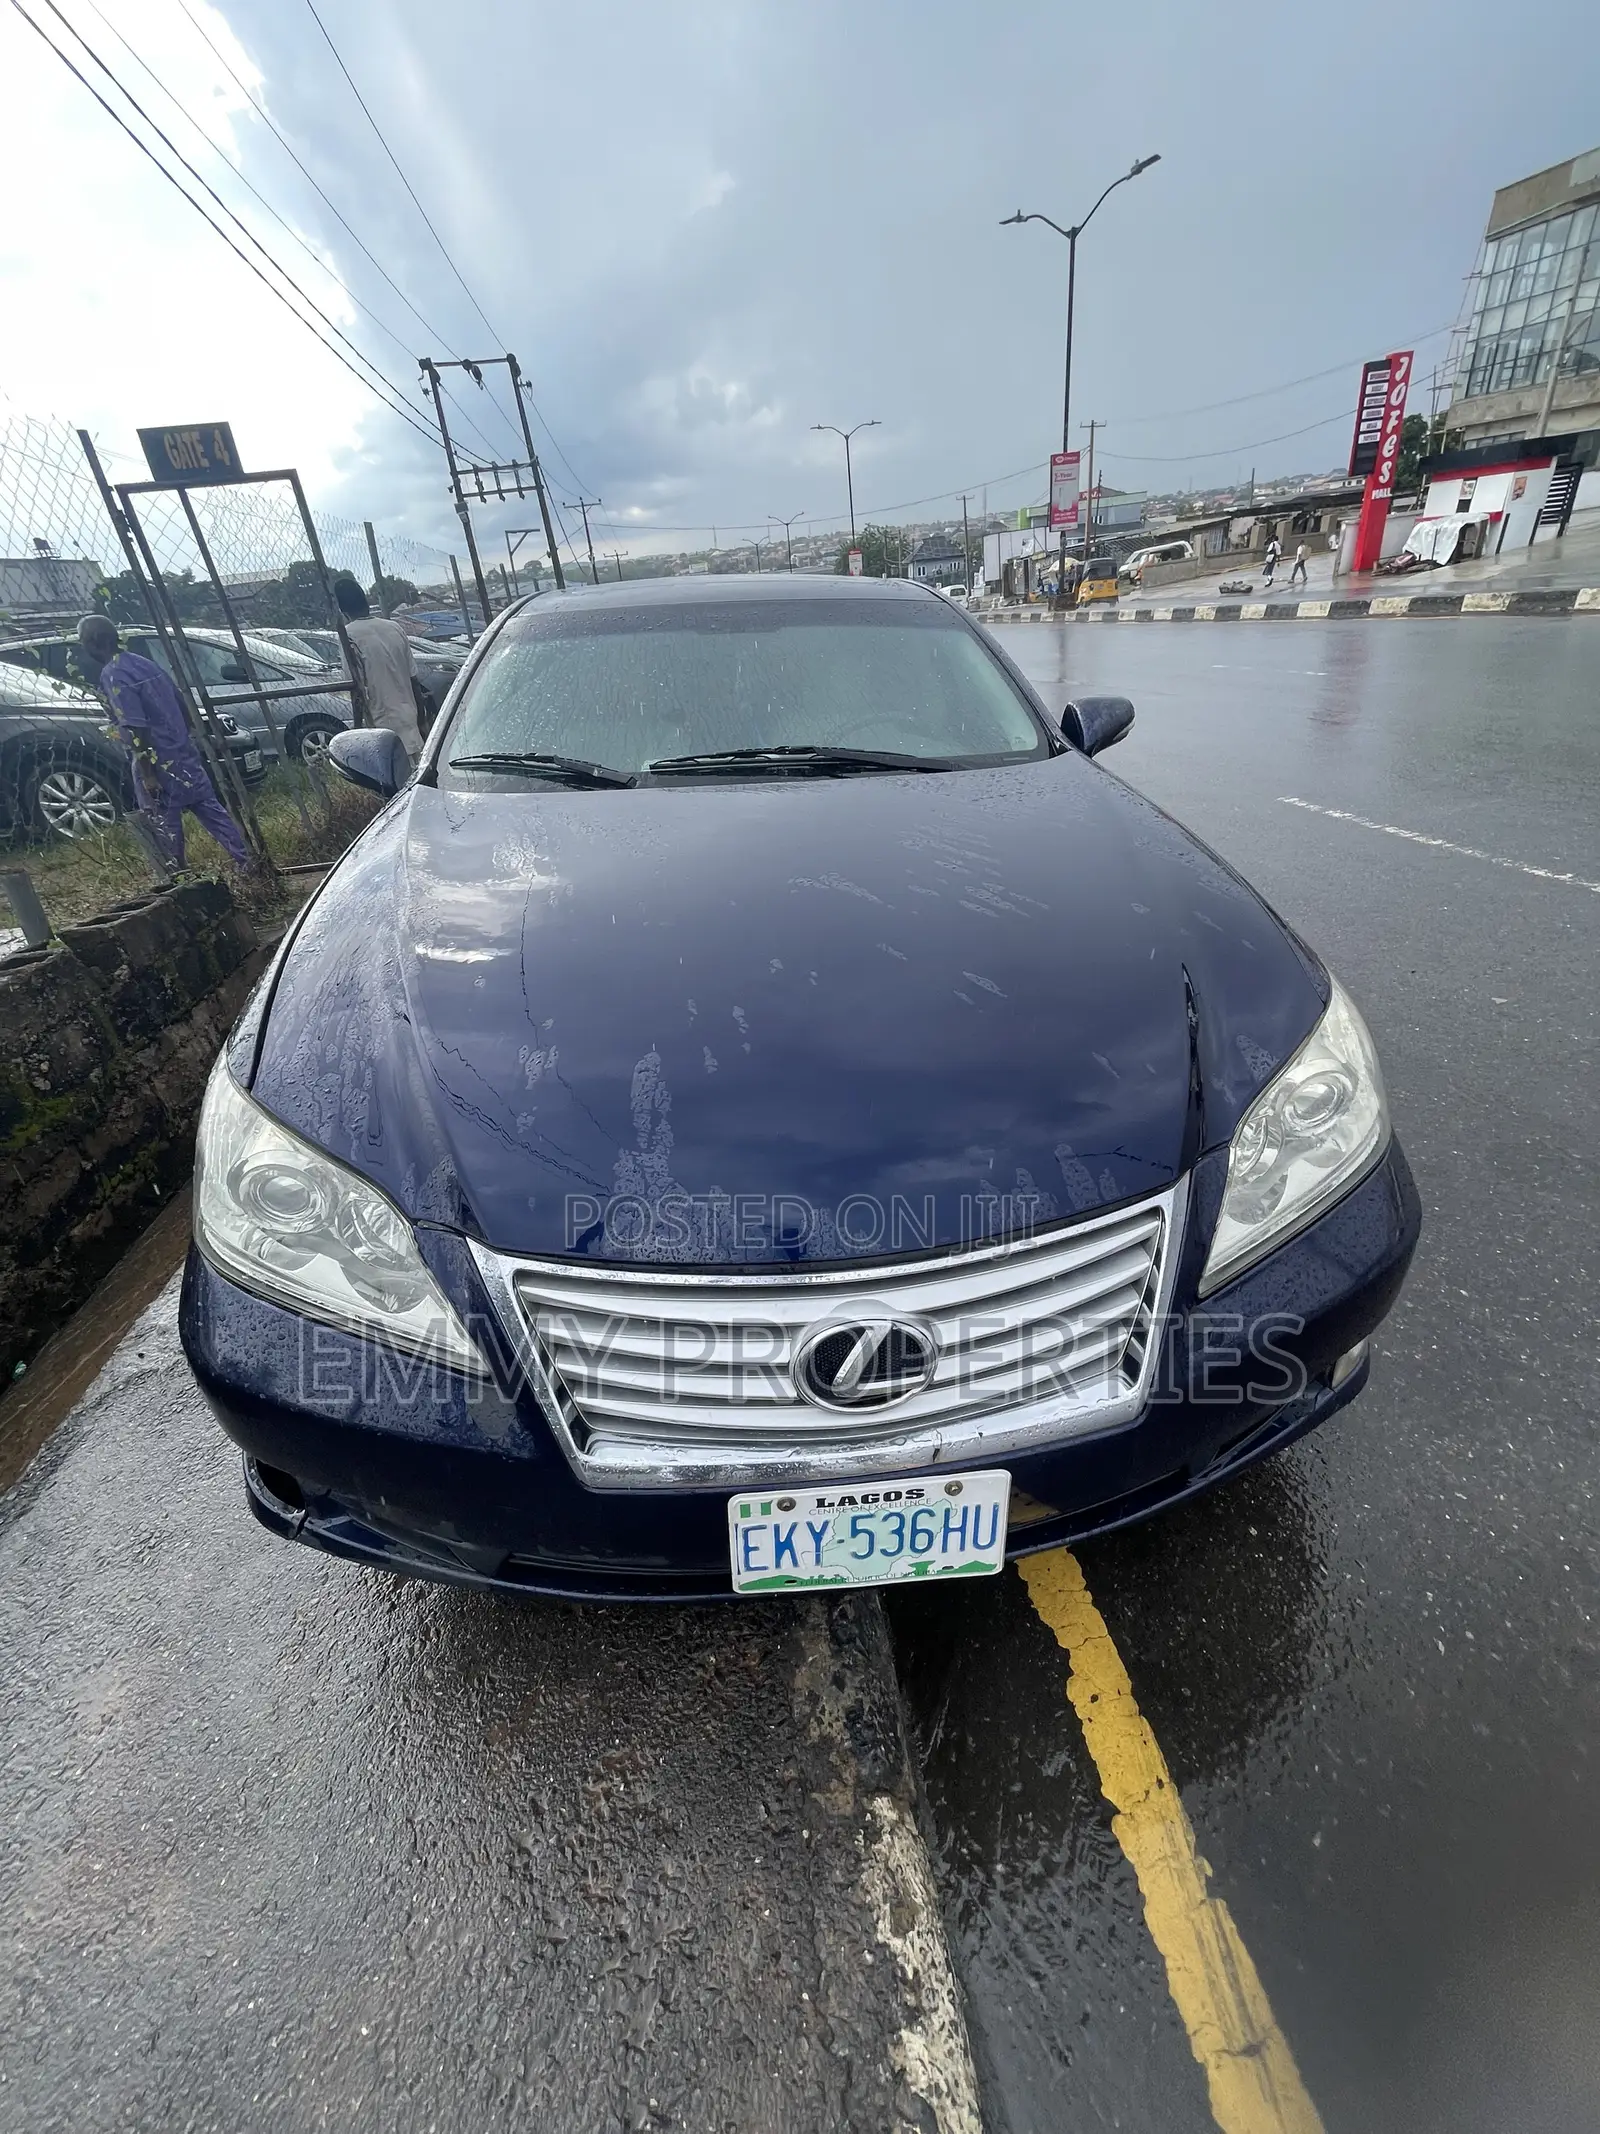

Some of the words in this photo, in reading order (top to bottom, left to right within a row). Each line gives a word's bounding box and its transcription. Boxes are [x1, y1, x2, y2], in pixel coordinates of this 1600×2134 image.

[163, 430, 210, 470] GATE
[213, 428, 231, 466] 4
[1372, 488, 1392, 499] MALL
[808, 1505, 849, 1517] CENTRE
[850, 1504, 867, 1513] OF
[867, 1497, 933, 1511] EXCELLENCE
[815, 1488, 926, 1509] LAGOS
